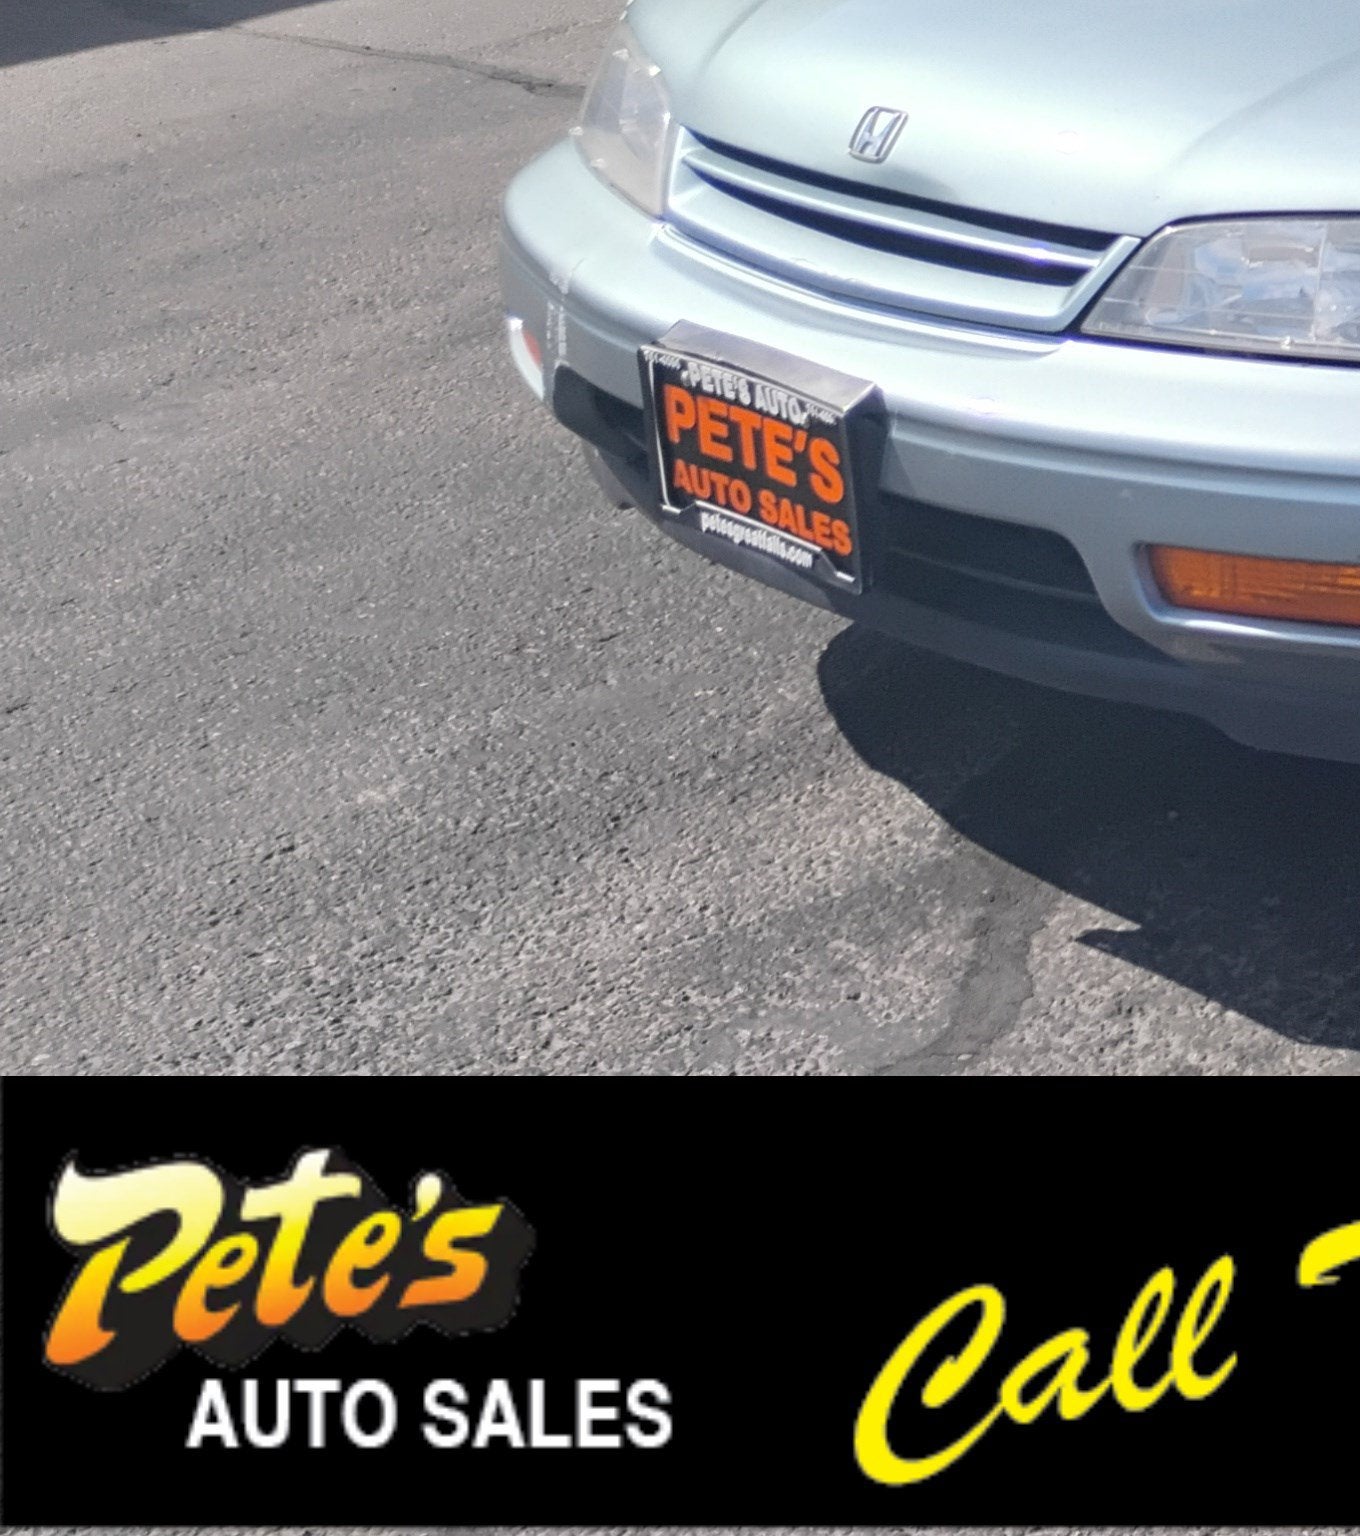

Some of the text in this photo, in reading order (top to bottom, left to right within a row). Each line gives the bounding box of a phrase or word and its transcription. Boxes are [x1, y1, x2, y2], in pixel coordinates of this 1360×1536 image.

[688, 361, 751, 406] PETE'S
[755, 381, 802, 424] AUTO
[662, 382, 845, 505] PETE'S
[673, 458, 853, 557] AUTO SALES
